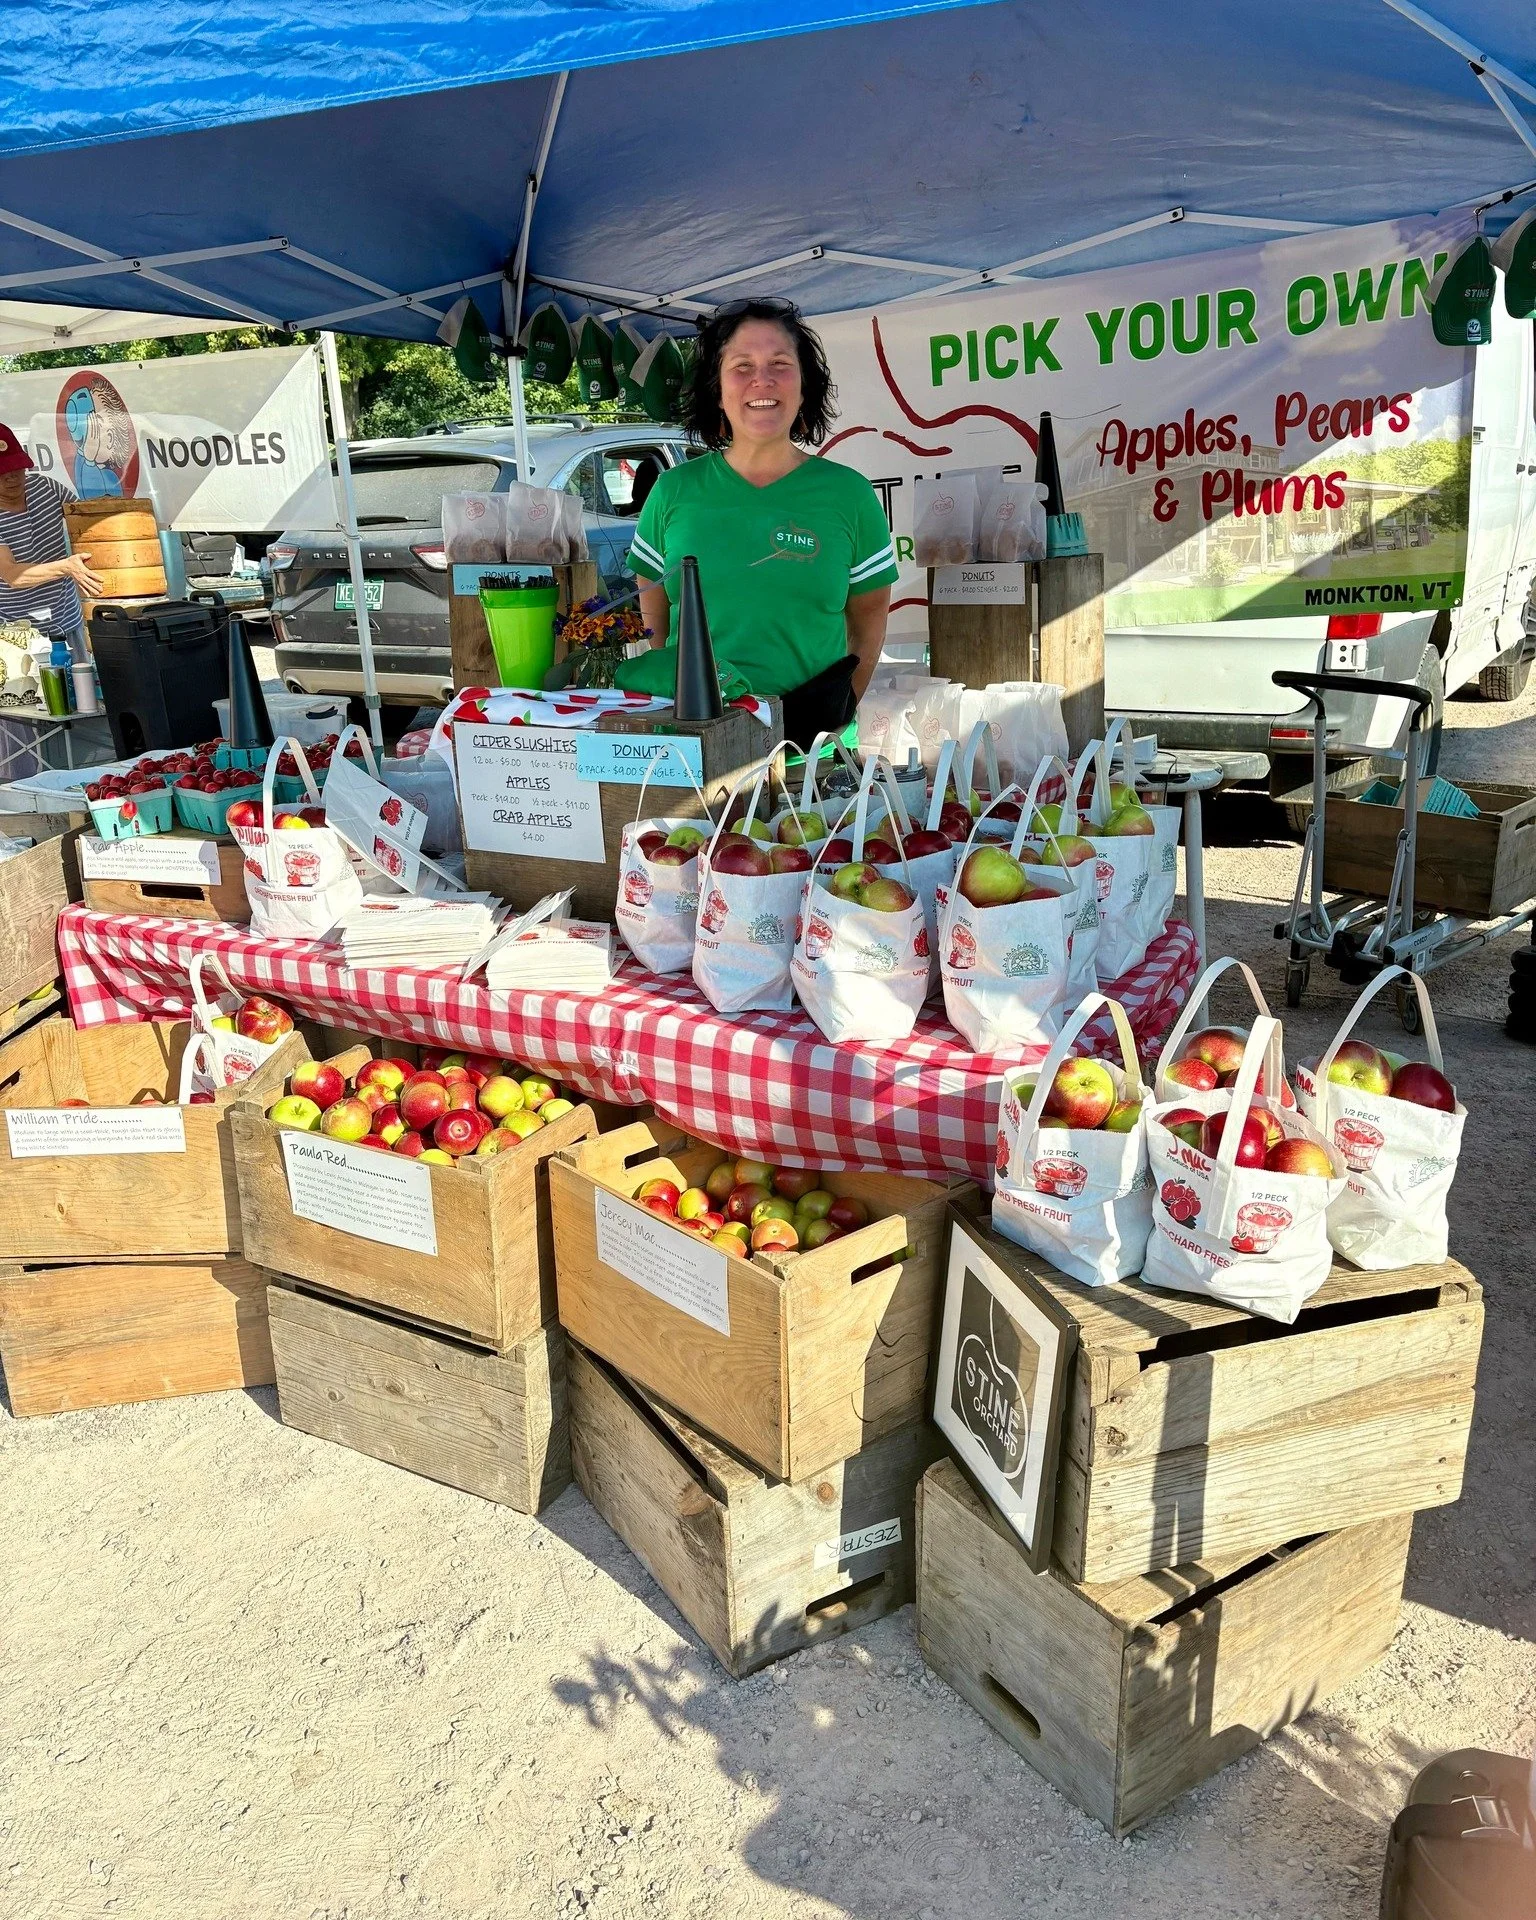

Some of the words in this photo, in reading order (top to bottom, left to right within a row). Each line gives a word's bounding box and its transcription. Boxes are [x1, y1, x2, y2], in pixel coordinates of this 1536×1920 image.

[1464, 288, 1490, 298] STINE
[931, 318, 1063, 386] PICK
[1085, 287, 1258, 365] YOUR
[1286, 252, 1448, 336] OWN
[1097, 408, 1252, 474] Apples,
[1275, 392, 1413, 446] Pears
[147, 432, 286, 468] NOODLES
[1153, 477, 1178, 522] &
[1202, 470, 1347, 520] Plums
[776, 532, 814, 547] STINE
[484, 571, 520, 580] DONUTS
[962, 571, 994, 581] DONUTS
[1305, 582, 1414, 606] MONKTON,
[1420, 582, 1452, 600] VT
[472, 735, 511, 748] CIDER
[514, 737, 577, 753] SLUSHIES
[612, 744, 669, 758] DONUTS
[500, 757, 521, 767] $5.00
[530, 759, 541, 768] 16
[578, 765, 583, 773] 6
[586, 765, 605, 774] PACK
[613, 766, 637, 776] $9.00
[506, 776, 550, 790] APPLES
[472, 792, 488, 801] Peck
[496, 794, 520, 804] $19.00
[542, 800, 558, 810] peck
[565, 800, 590, 811] $11.00
[492, 810, 524, 823] CRAB
[527, 814, 572, 828] APPLES
[522, 832, 544, 842] $4.00
[298, 894, 318, 902] FRUIT
[632, 912, 646, 923] FRUIT
[950, 977, 974, 987] FRUIT
[11, 1112, 58, 1124] William
[1344, 1108, 1355, 1116] 1/2
[1357, 1112, 1380, 1123] PECK
[290, 1144, 322, 1162] Paula
[1056, 1150, 1080, 1158] PECK
[1166, 1152, 1188, 1170] Produce
[1196, 1170, 1209, 1182] USA
[1347, 1181, 1366, 1196] RUIT
[1251, 1192, 1262, 1200] 1/2
[1264, 1194, 1288, 1203] PECK
[1012, 1198, 1042, 1214] FRESH
[1044, 1208, 1072, 1223] FRUIT
[600, 1204, 632, 1235] Jersey
[966, 1356, 1020, 1444] STINE
[973, 1396, 1017, 1457] ORCHARD
[825, 1524, 898, 1558] ZESTAR
